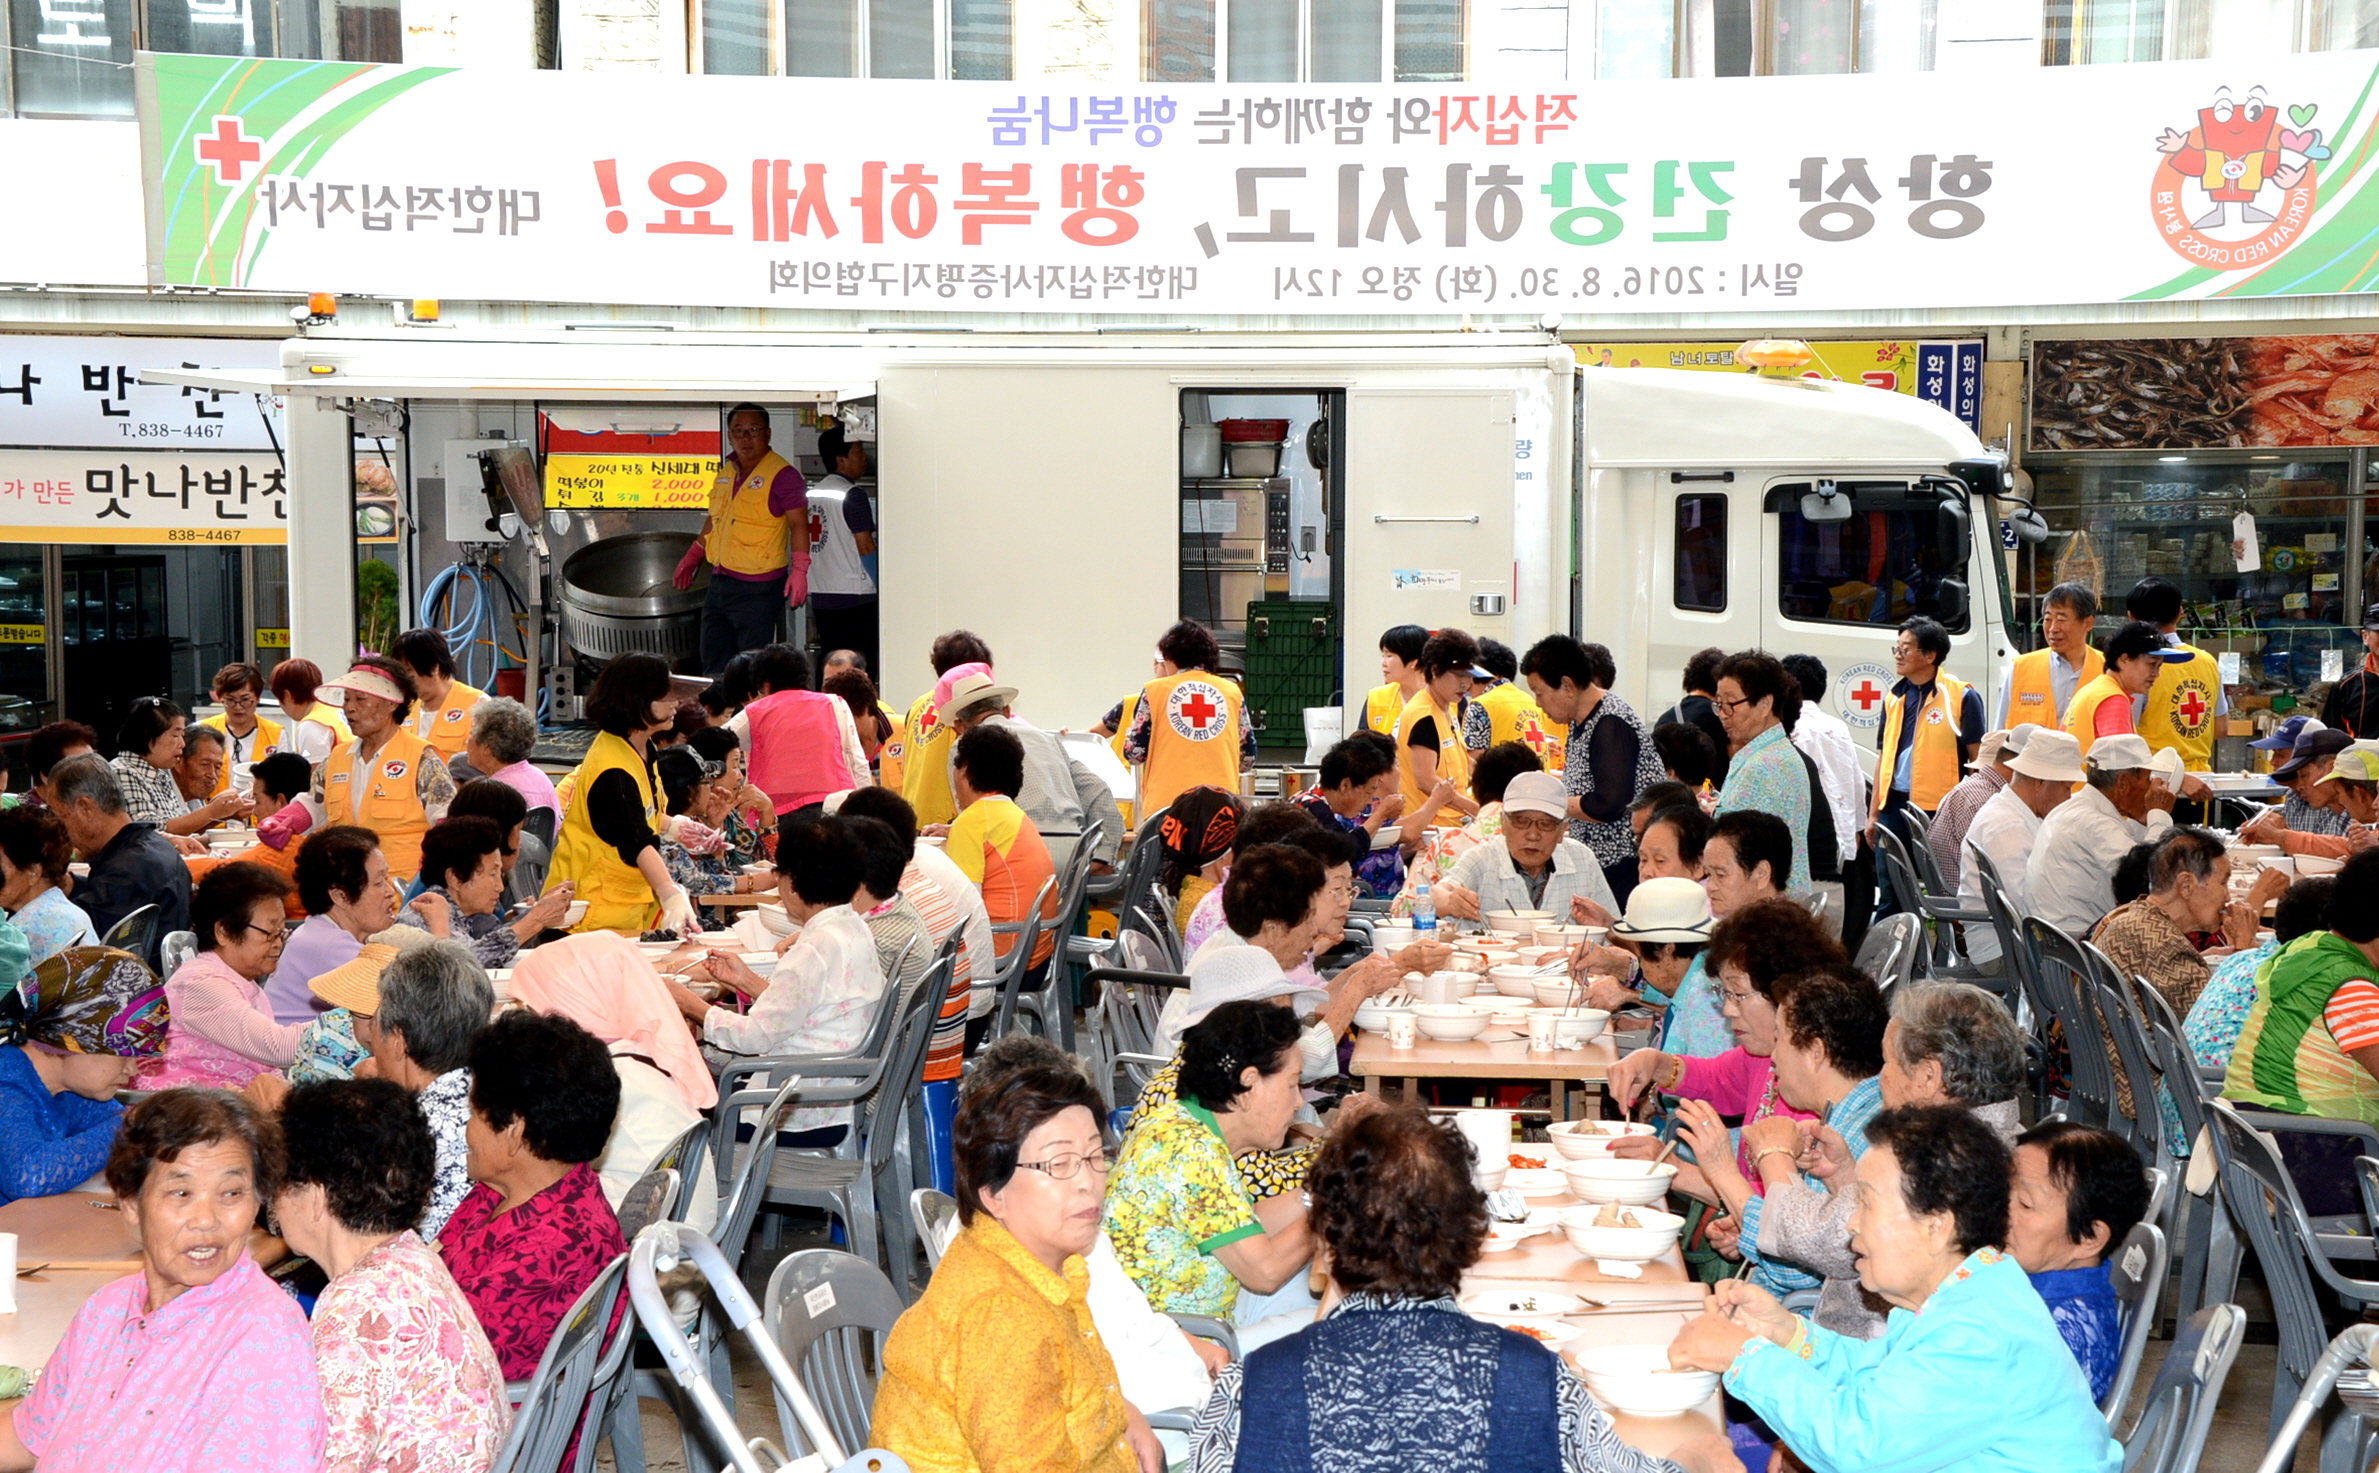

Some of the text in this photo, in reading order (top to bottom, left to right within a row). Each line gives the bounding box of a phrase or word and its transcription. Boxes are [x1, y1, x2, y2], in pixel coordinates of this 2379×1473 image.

[651, 461, 700, 475] 신세대
[33, 480, 76, 505] 만든
[557, 476, 604, 490] 떡볶이
[652, 479, 705, 490] 2,000
[654, 492, 705, 503] 1,000
[168, 530, 241, 541] 838-4467
[1840, 664, 1894, 685] KOREAN RED CROSS
[1170, 682, 1225, 705] 대한적십자사
[2170, 678, 2212, 705] 대한적십자사
[1169, 711, 1227, 740] KOREAN RED CROSS
[2169, 711, 2187, 738] KOREAN
[2198, 706, 2212, 733] CROSS
